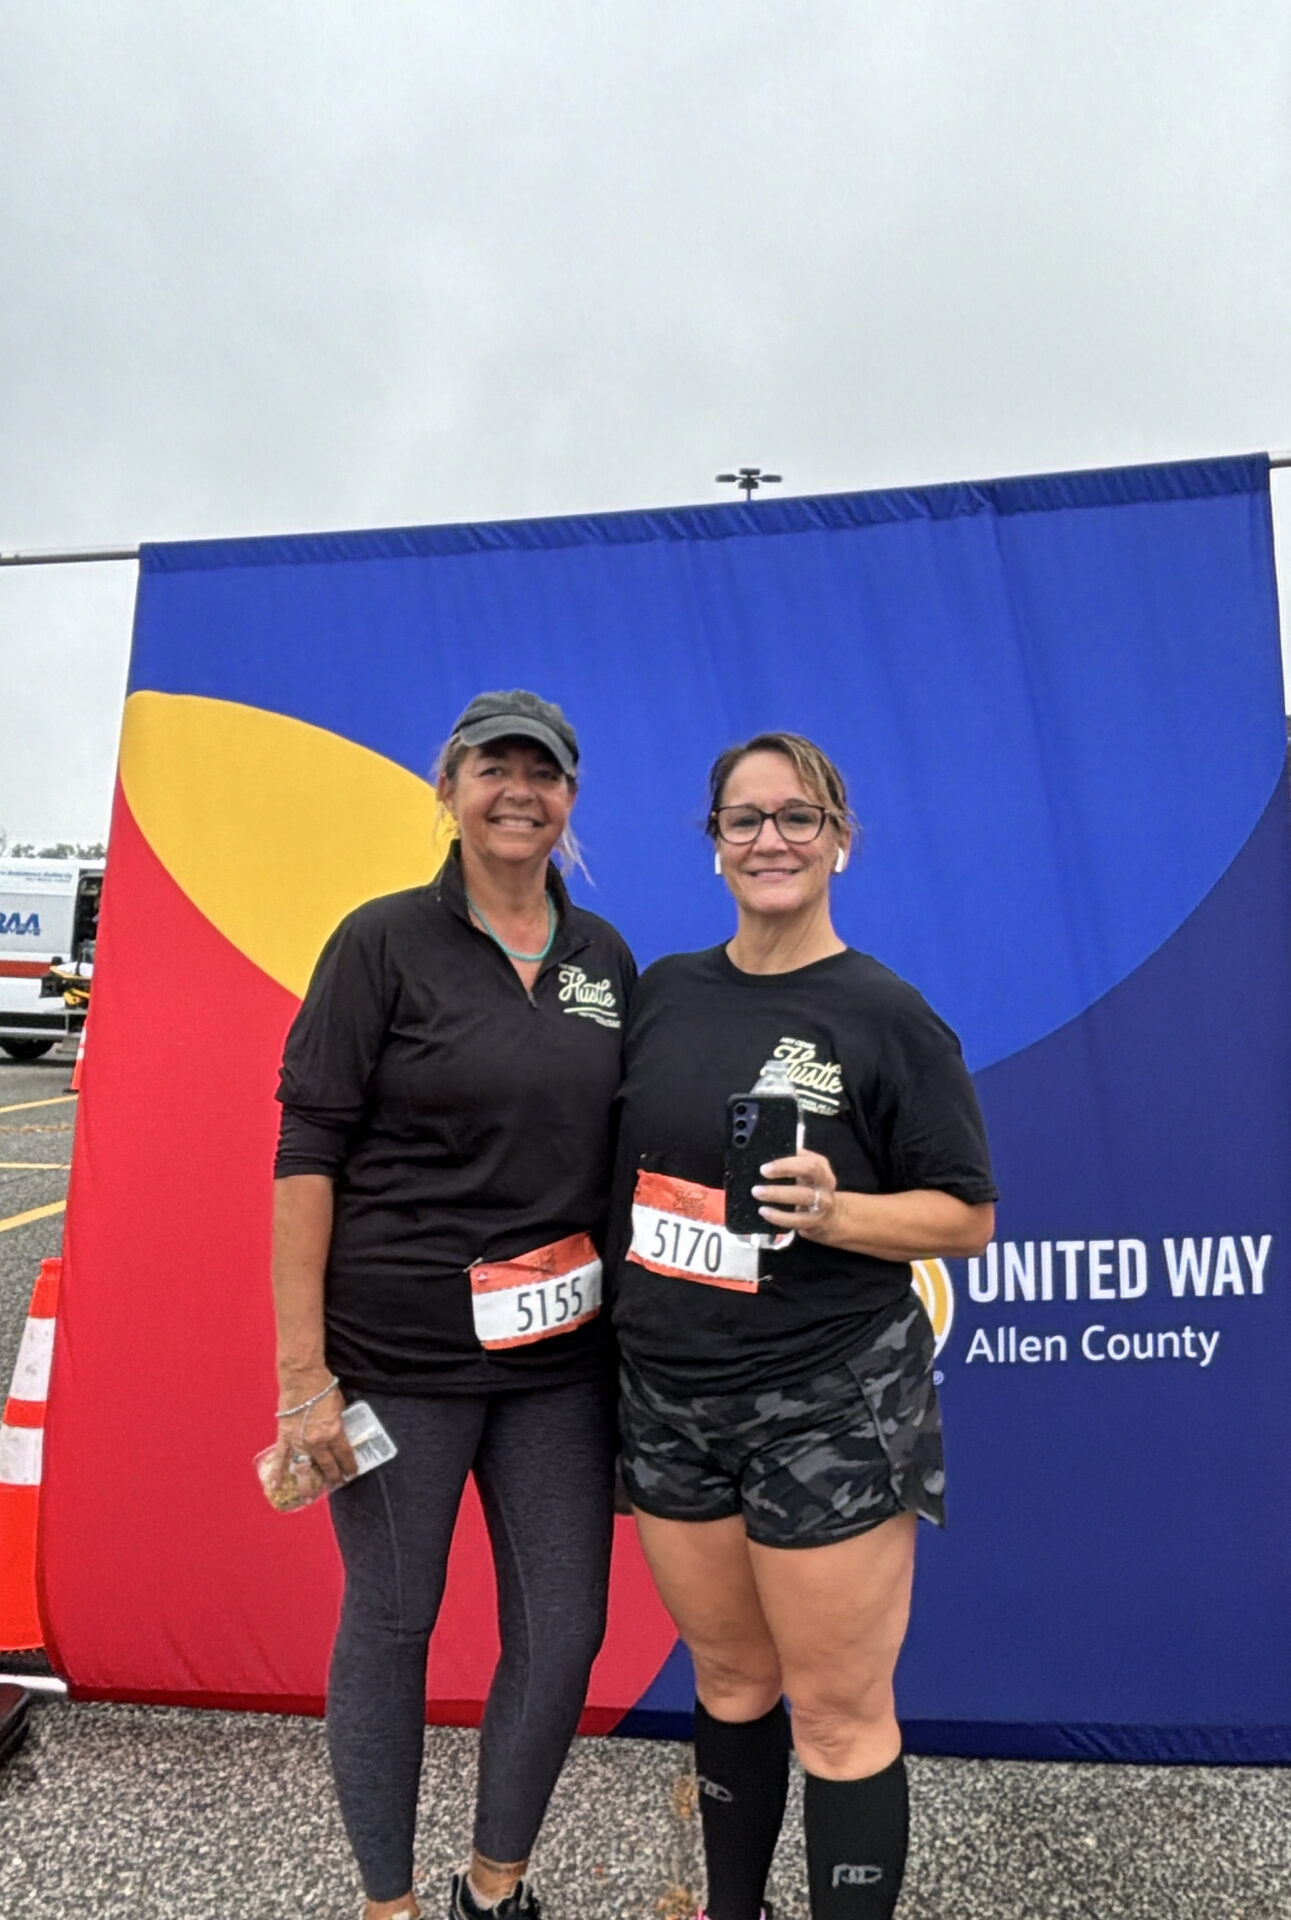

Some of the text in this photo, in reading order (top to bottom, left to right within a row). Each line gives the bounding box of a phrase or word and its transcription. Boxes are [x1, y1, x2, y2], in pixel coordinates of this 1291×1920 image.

[558, 970, 616, 1008] Hustle
[650, 1219, 722, 1273] 5170
[967, 1235, 1272, 1303] UNITED WAY
[517, 1276, 582, 1332] 5155
[965, 1324, 1220, 1368] Allen County
